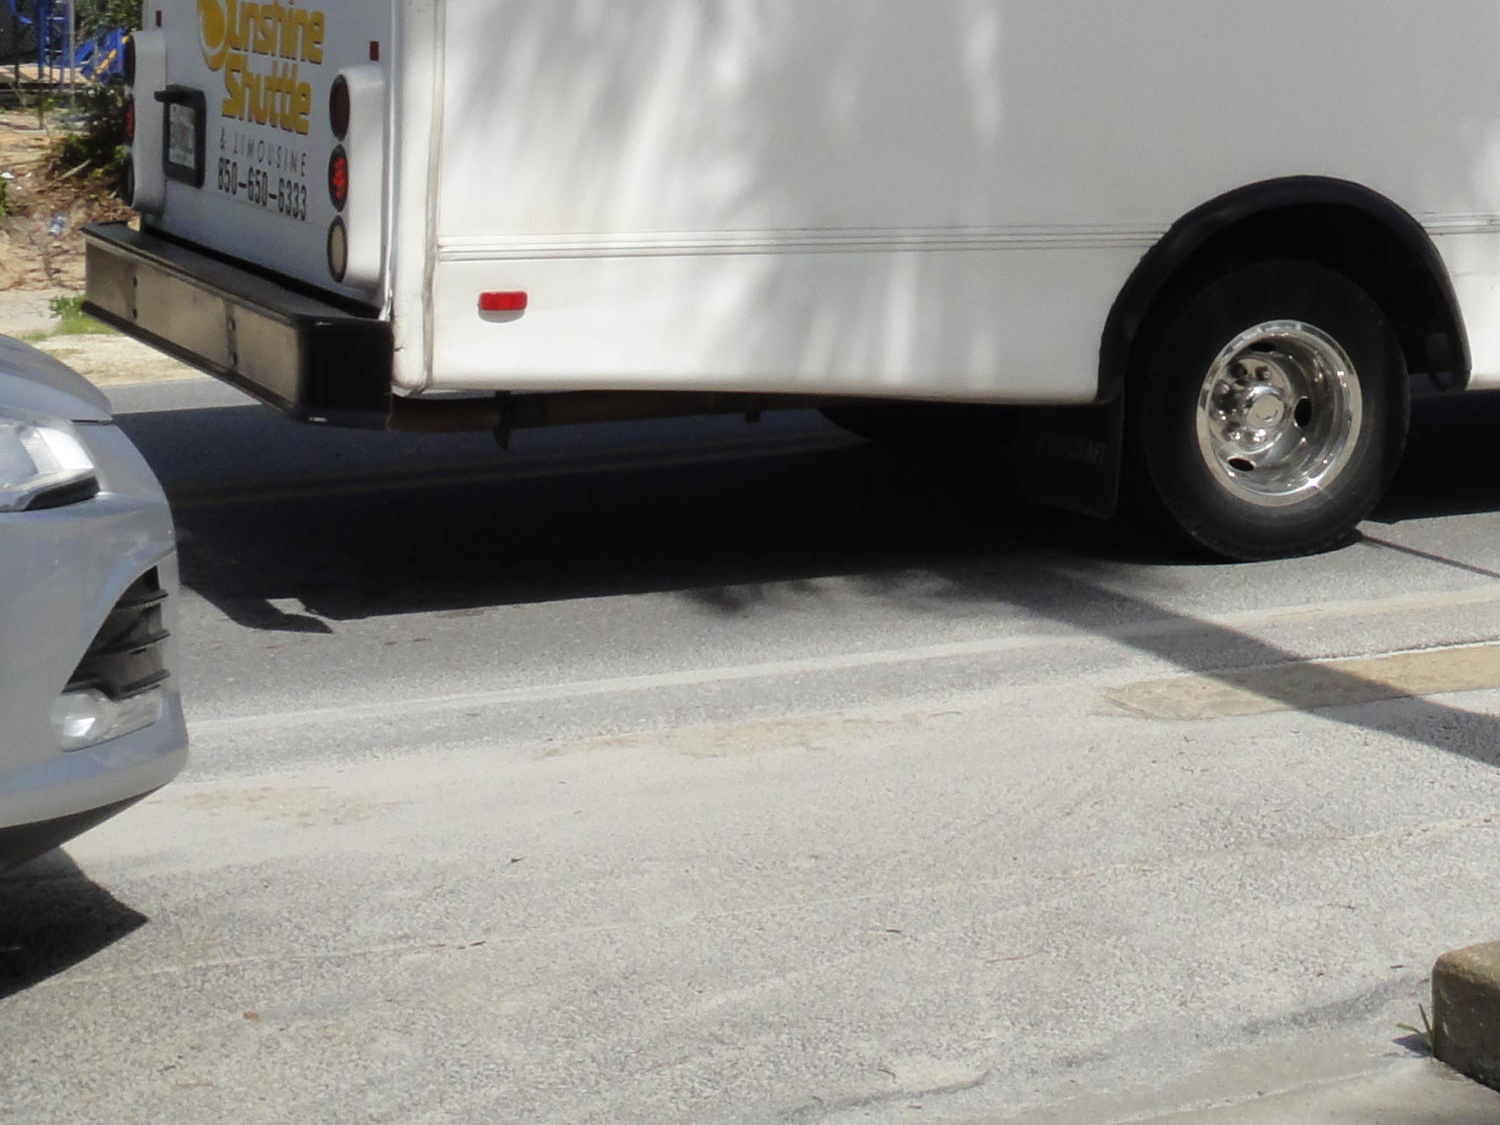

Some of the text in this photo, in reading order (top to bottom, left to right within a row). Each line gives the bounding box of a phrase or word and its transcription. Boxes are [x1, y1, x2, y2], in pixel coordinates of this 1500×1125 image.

[221, 53, 311, 136] Shuttle
[233, 131, 307, 177] LIMOUSINE
[218, 157, 307, 222] 850-650-6333
